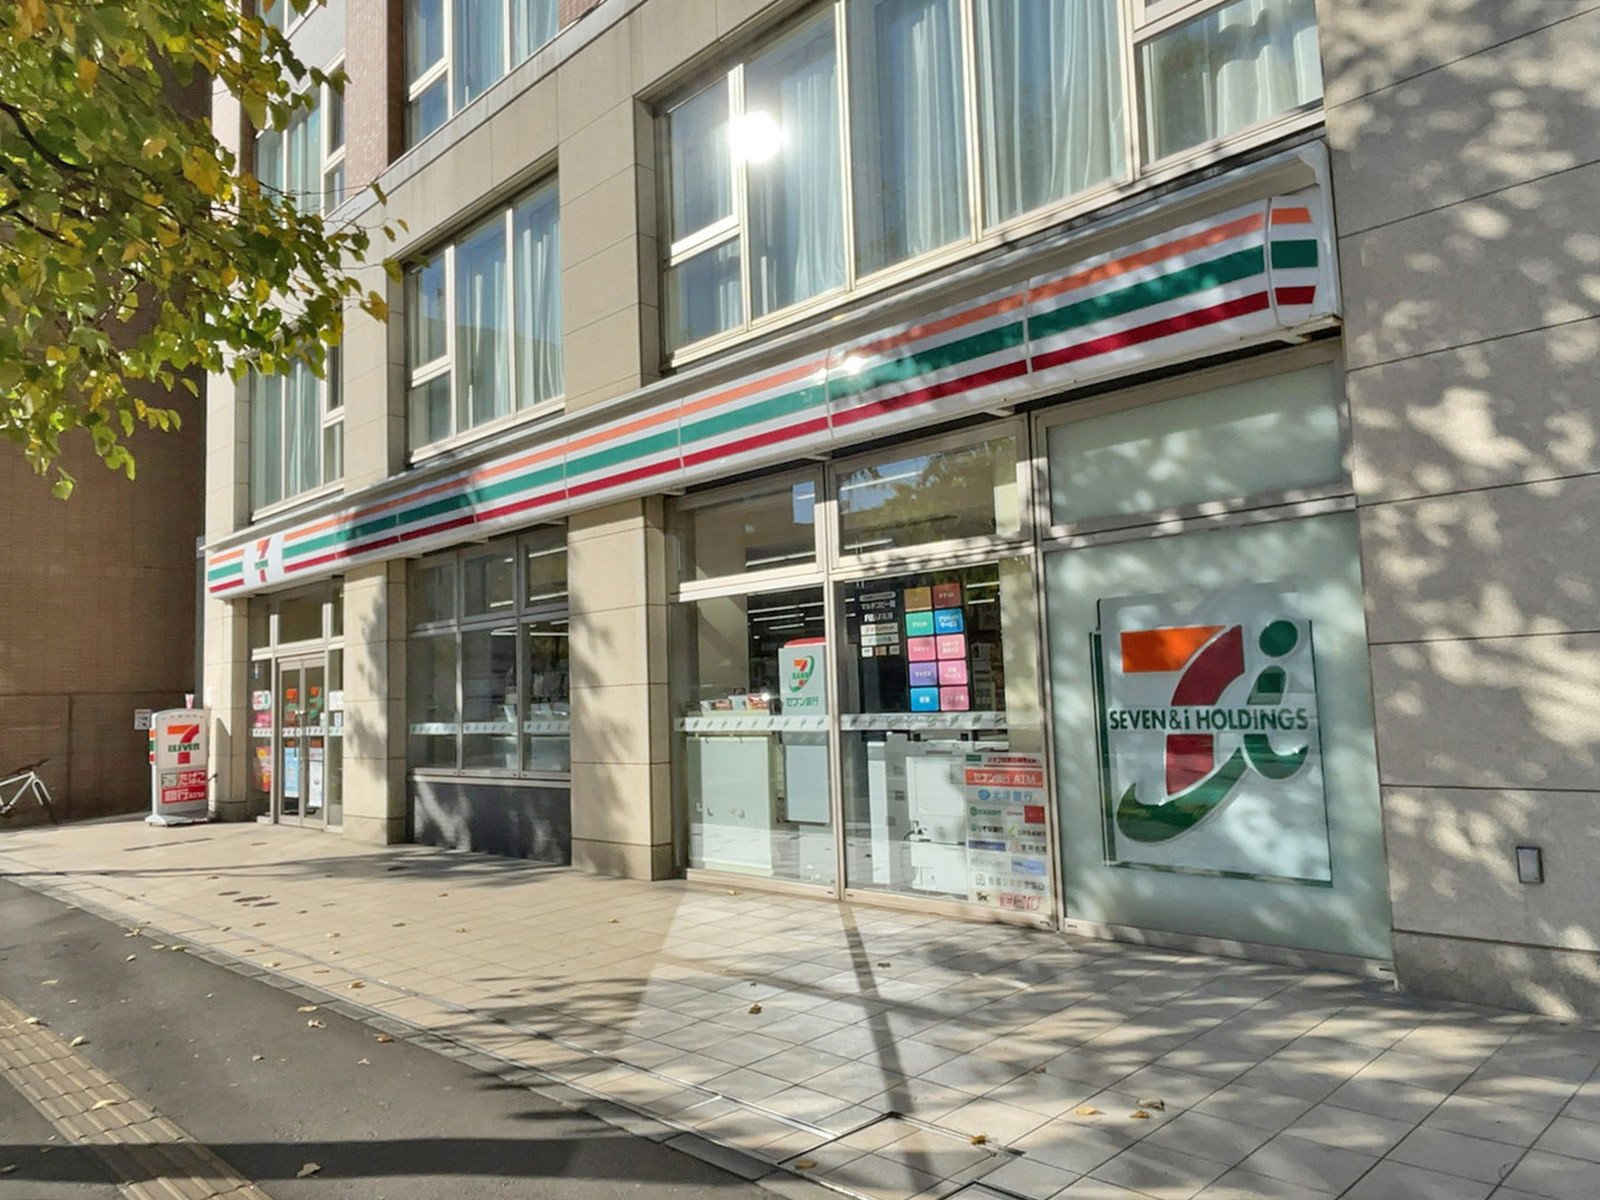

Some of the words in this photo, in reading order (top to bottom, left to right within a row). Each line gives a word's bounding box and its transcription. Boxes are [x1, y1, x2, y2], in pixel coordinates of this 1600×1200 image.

[786, 696, 819, 707] セブン銀行
[1196, 708, 1309, 730] HOLDINGS
[1013, 774, 1036, 784] ATM
